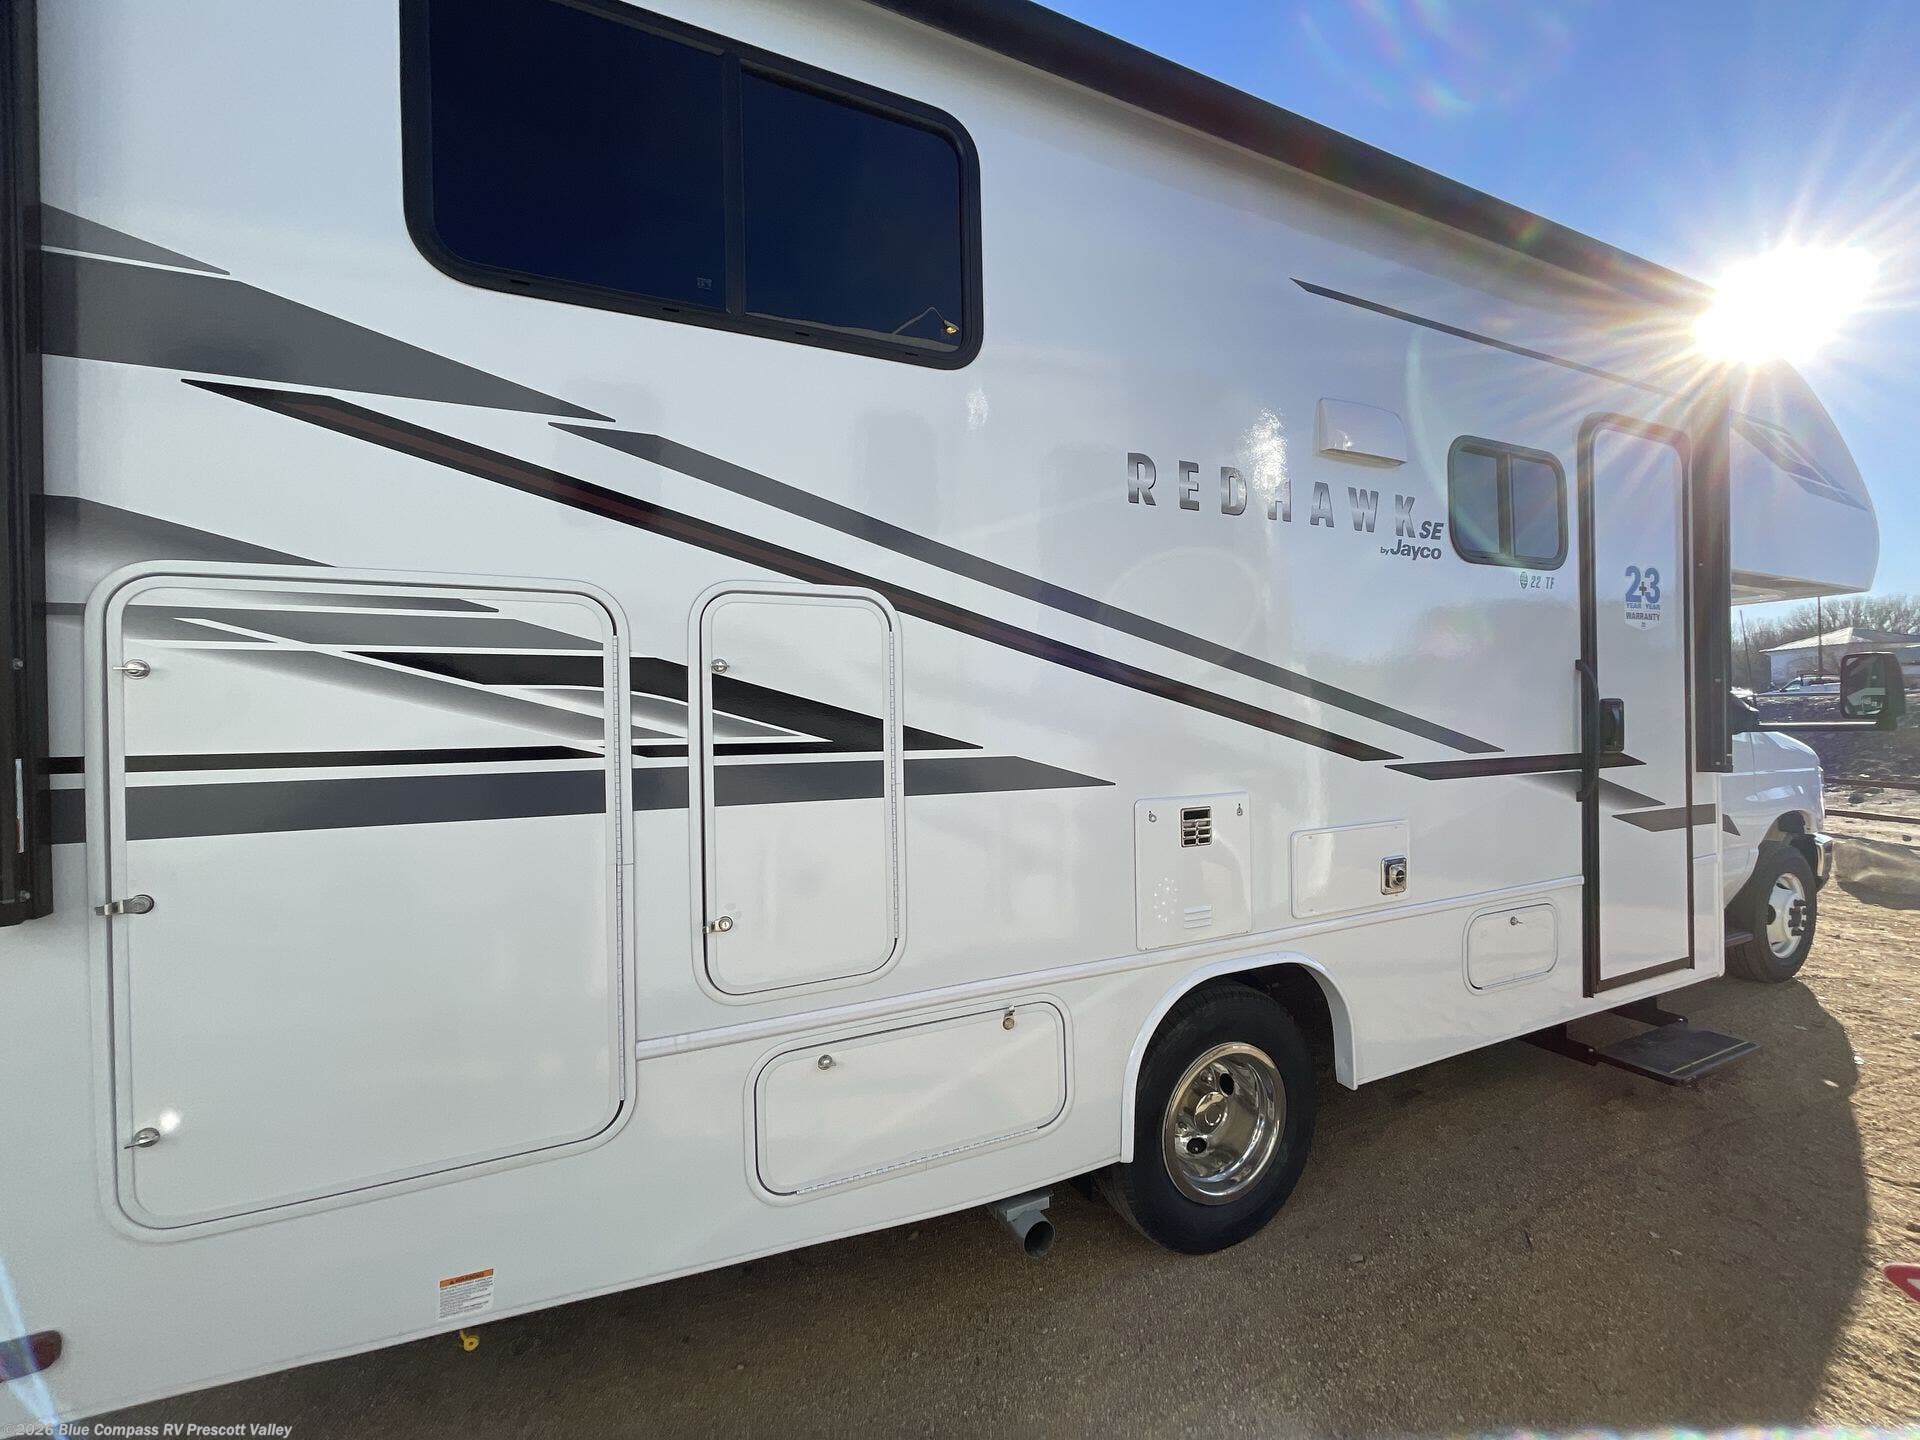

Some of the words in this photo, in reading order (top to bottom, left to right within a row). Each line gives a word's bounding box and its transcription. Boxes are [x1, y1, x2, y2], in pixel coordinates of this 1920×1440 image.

[1127, 452, 1416, 538] REDHAWK
[1419, 520, 1444, 540] SE
[1390, 539, 1442, 560] Jayco
[1530, 575, 1542, 588] 22
[1625, 611, 1661, 621] WARRANTY
